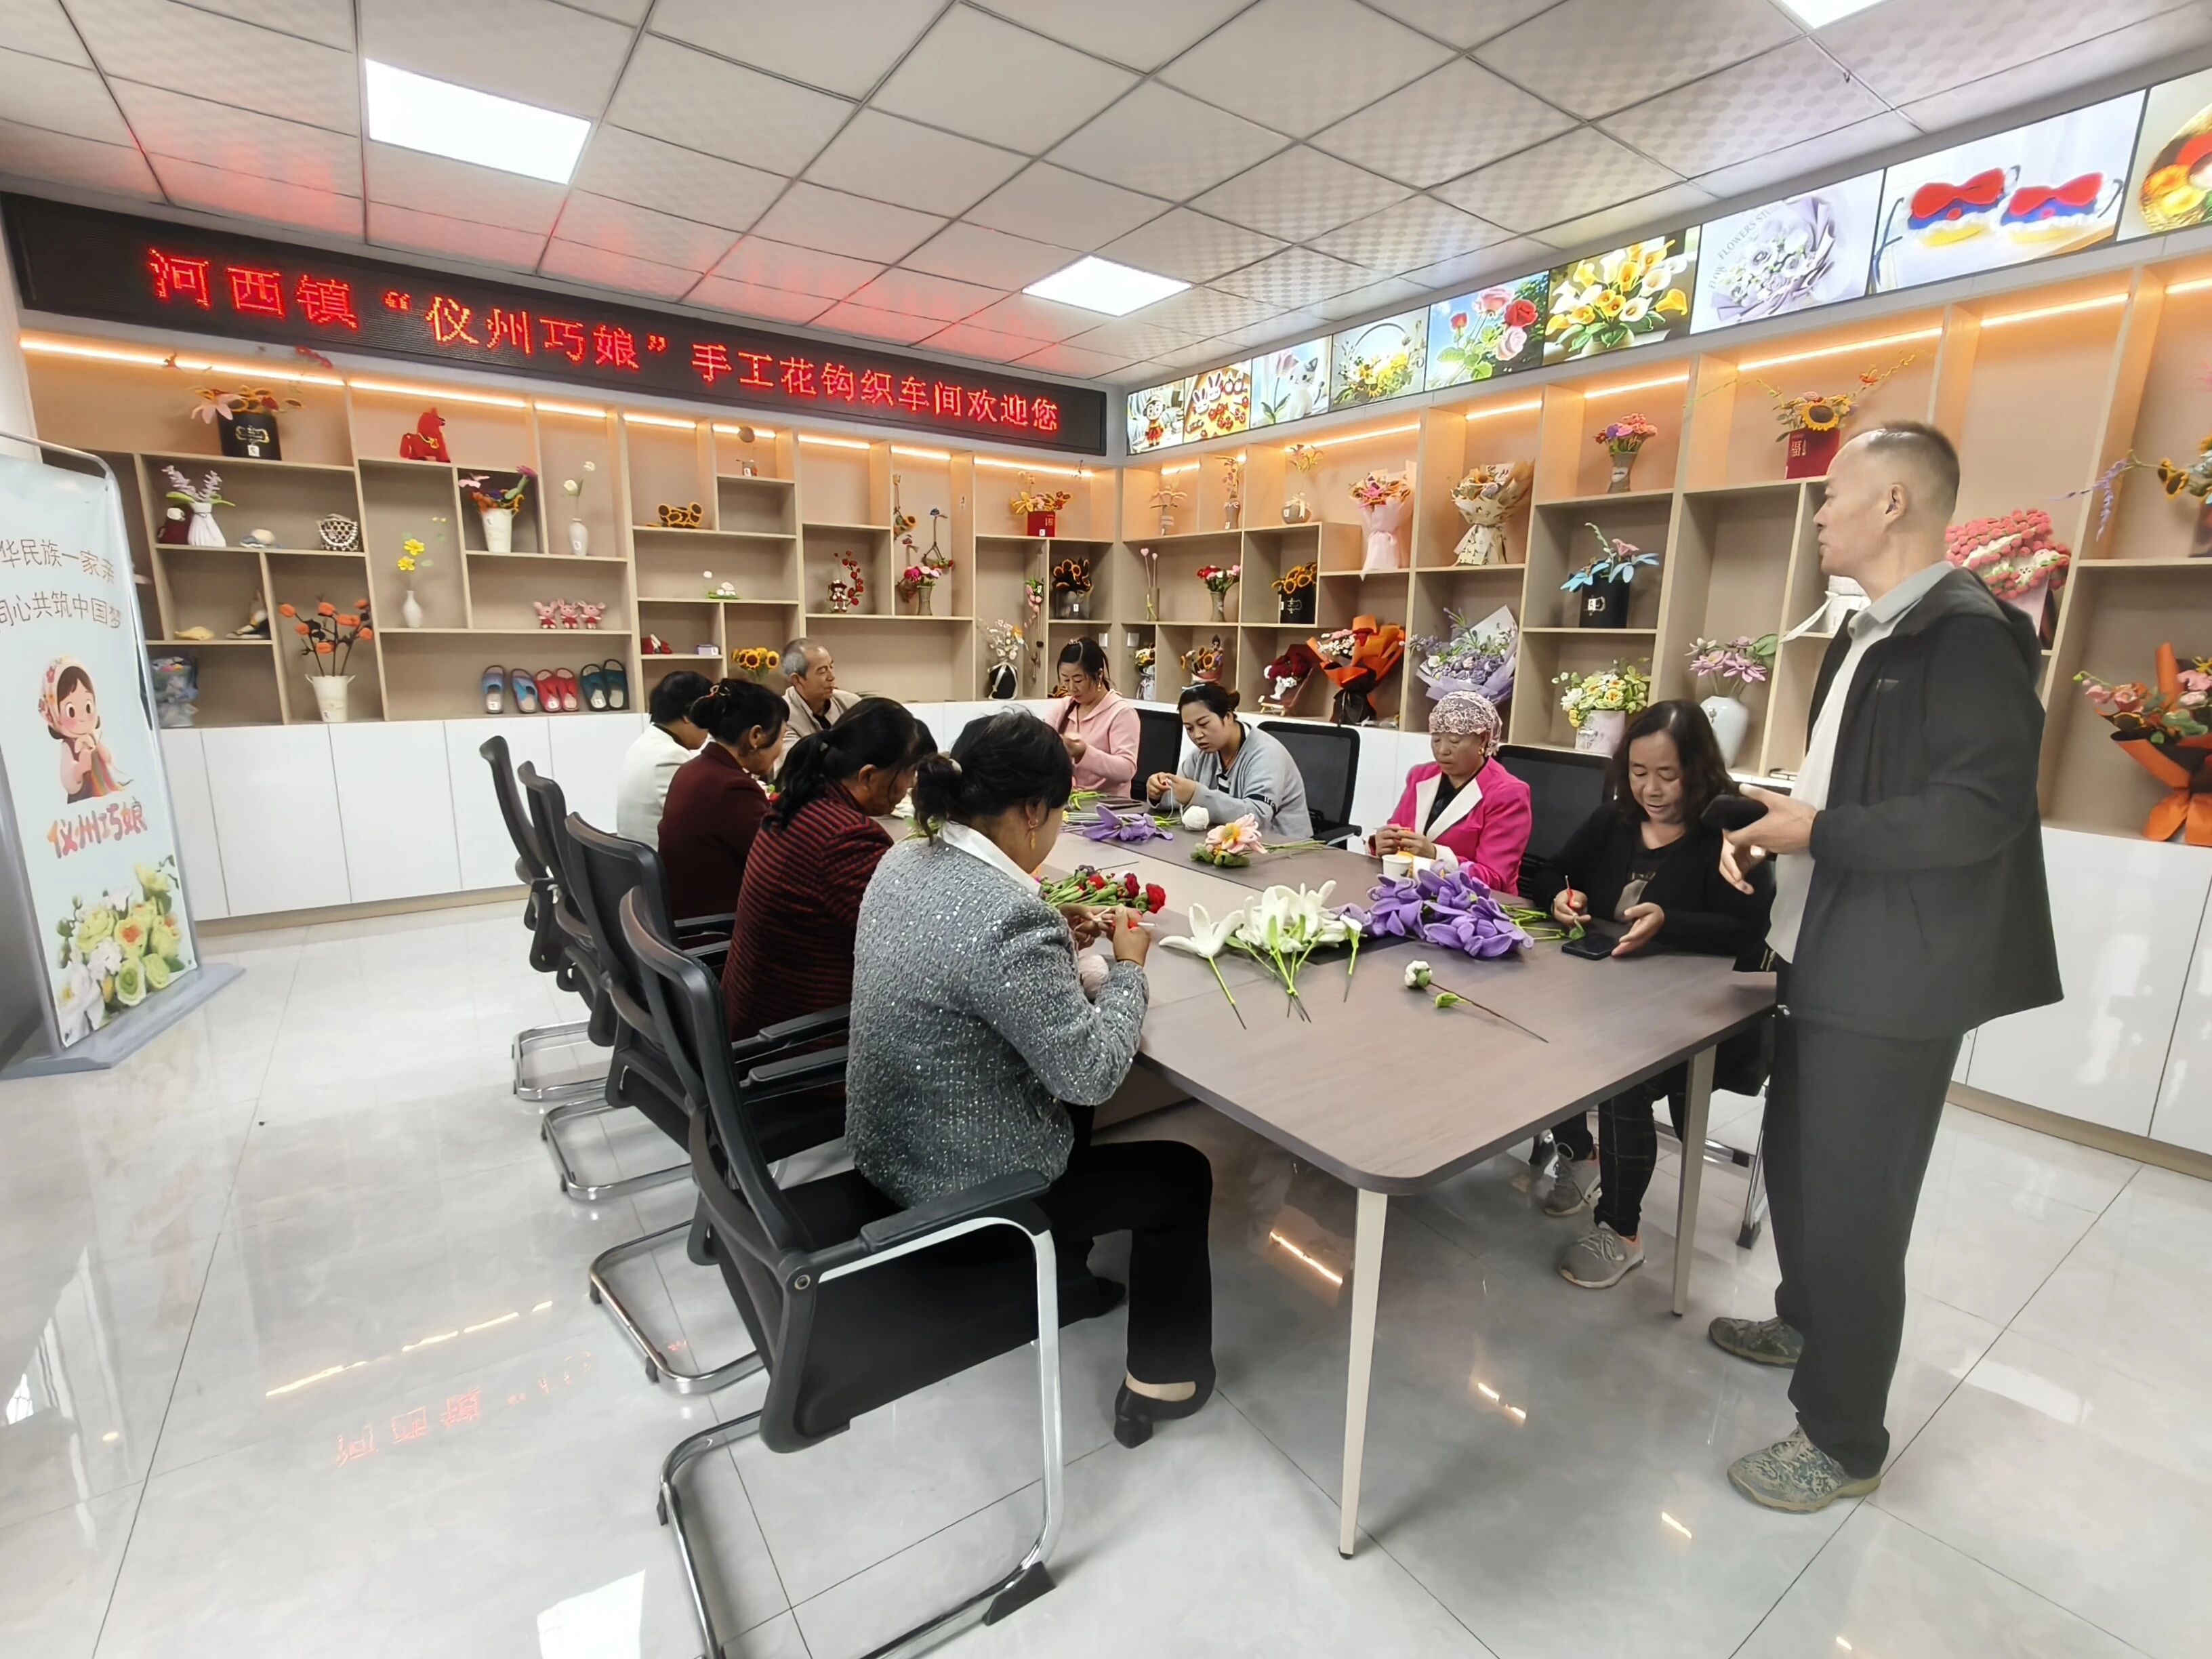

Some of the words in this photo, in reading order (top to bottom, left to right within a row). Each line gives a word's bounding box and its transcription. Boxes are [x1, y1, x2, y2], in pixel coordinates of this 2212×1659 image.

[1718, 221, 1757, 259] FLOWERS
[47, 796, 148, 859] 仪州巧娘
